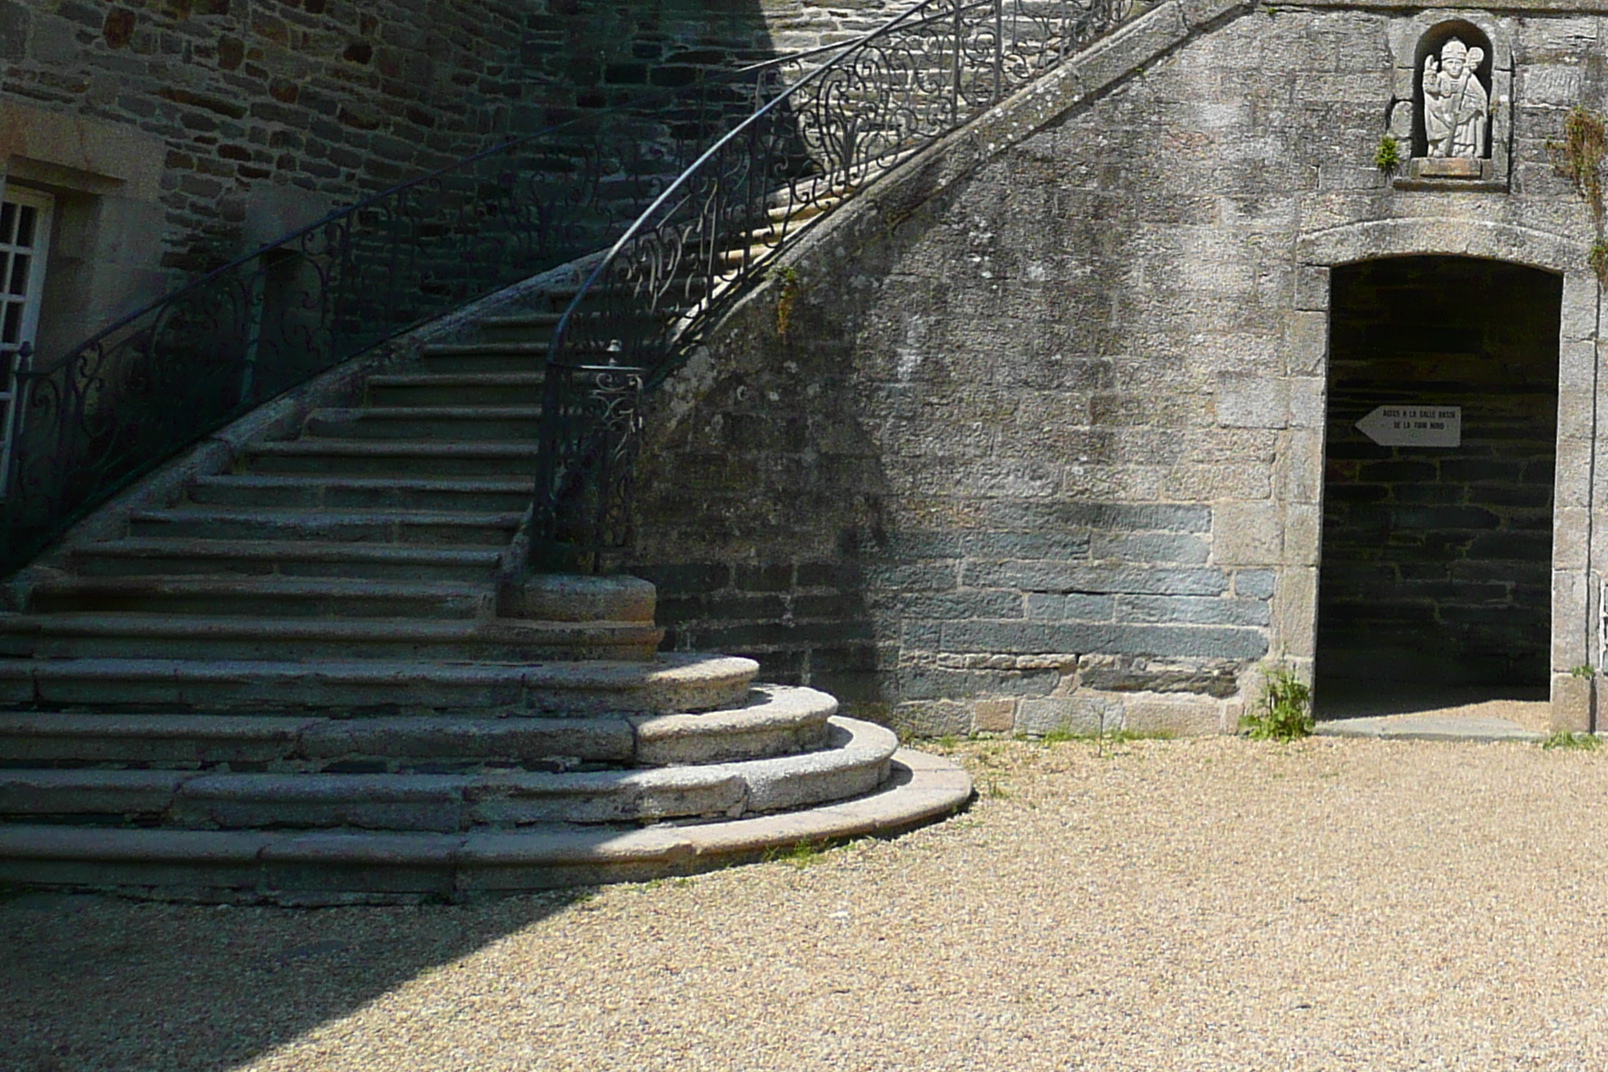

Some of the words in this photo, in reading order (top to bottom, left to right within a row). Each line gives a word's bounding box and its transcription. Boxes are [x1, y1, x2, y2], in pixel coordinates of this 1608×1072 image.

[1409, 410, 1416, 418] LA
[1394, 421, 1401, 429] DE
[1403, 421, 1410, 429] LA
